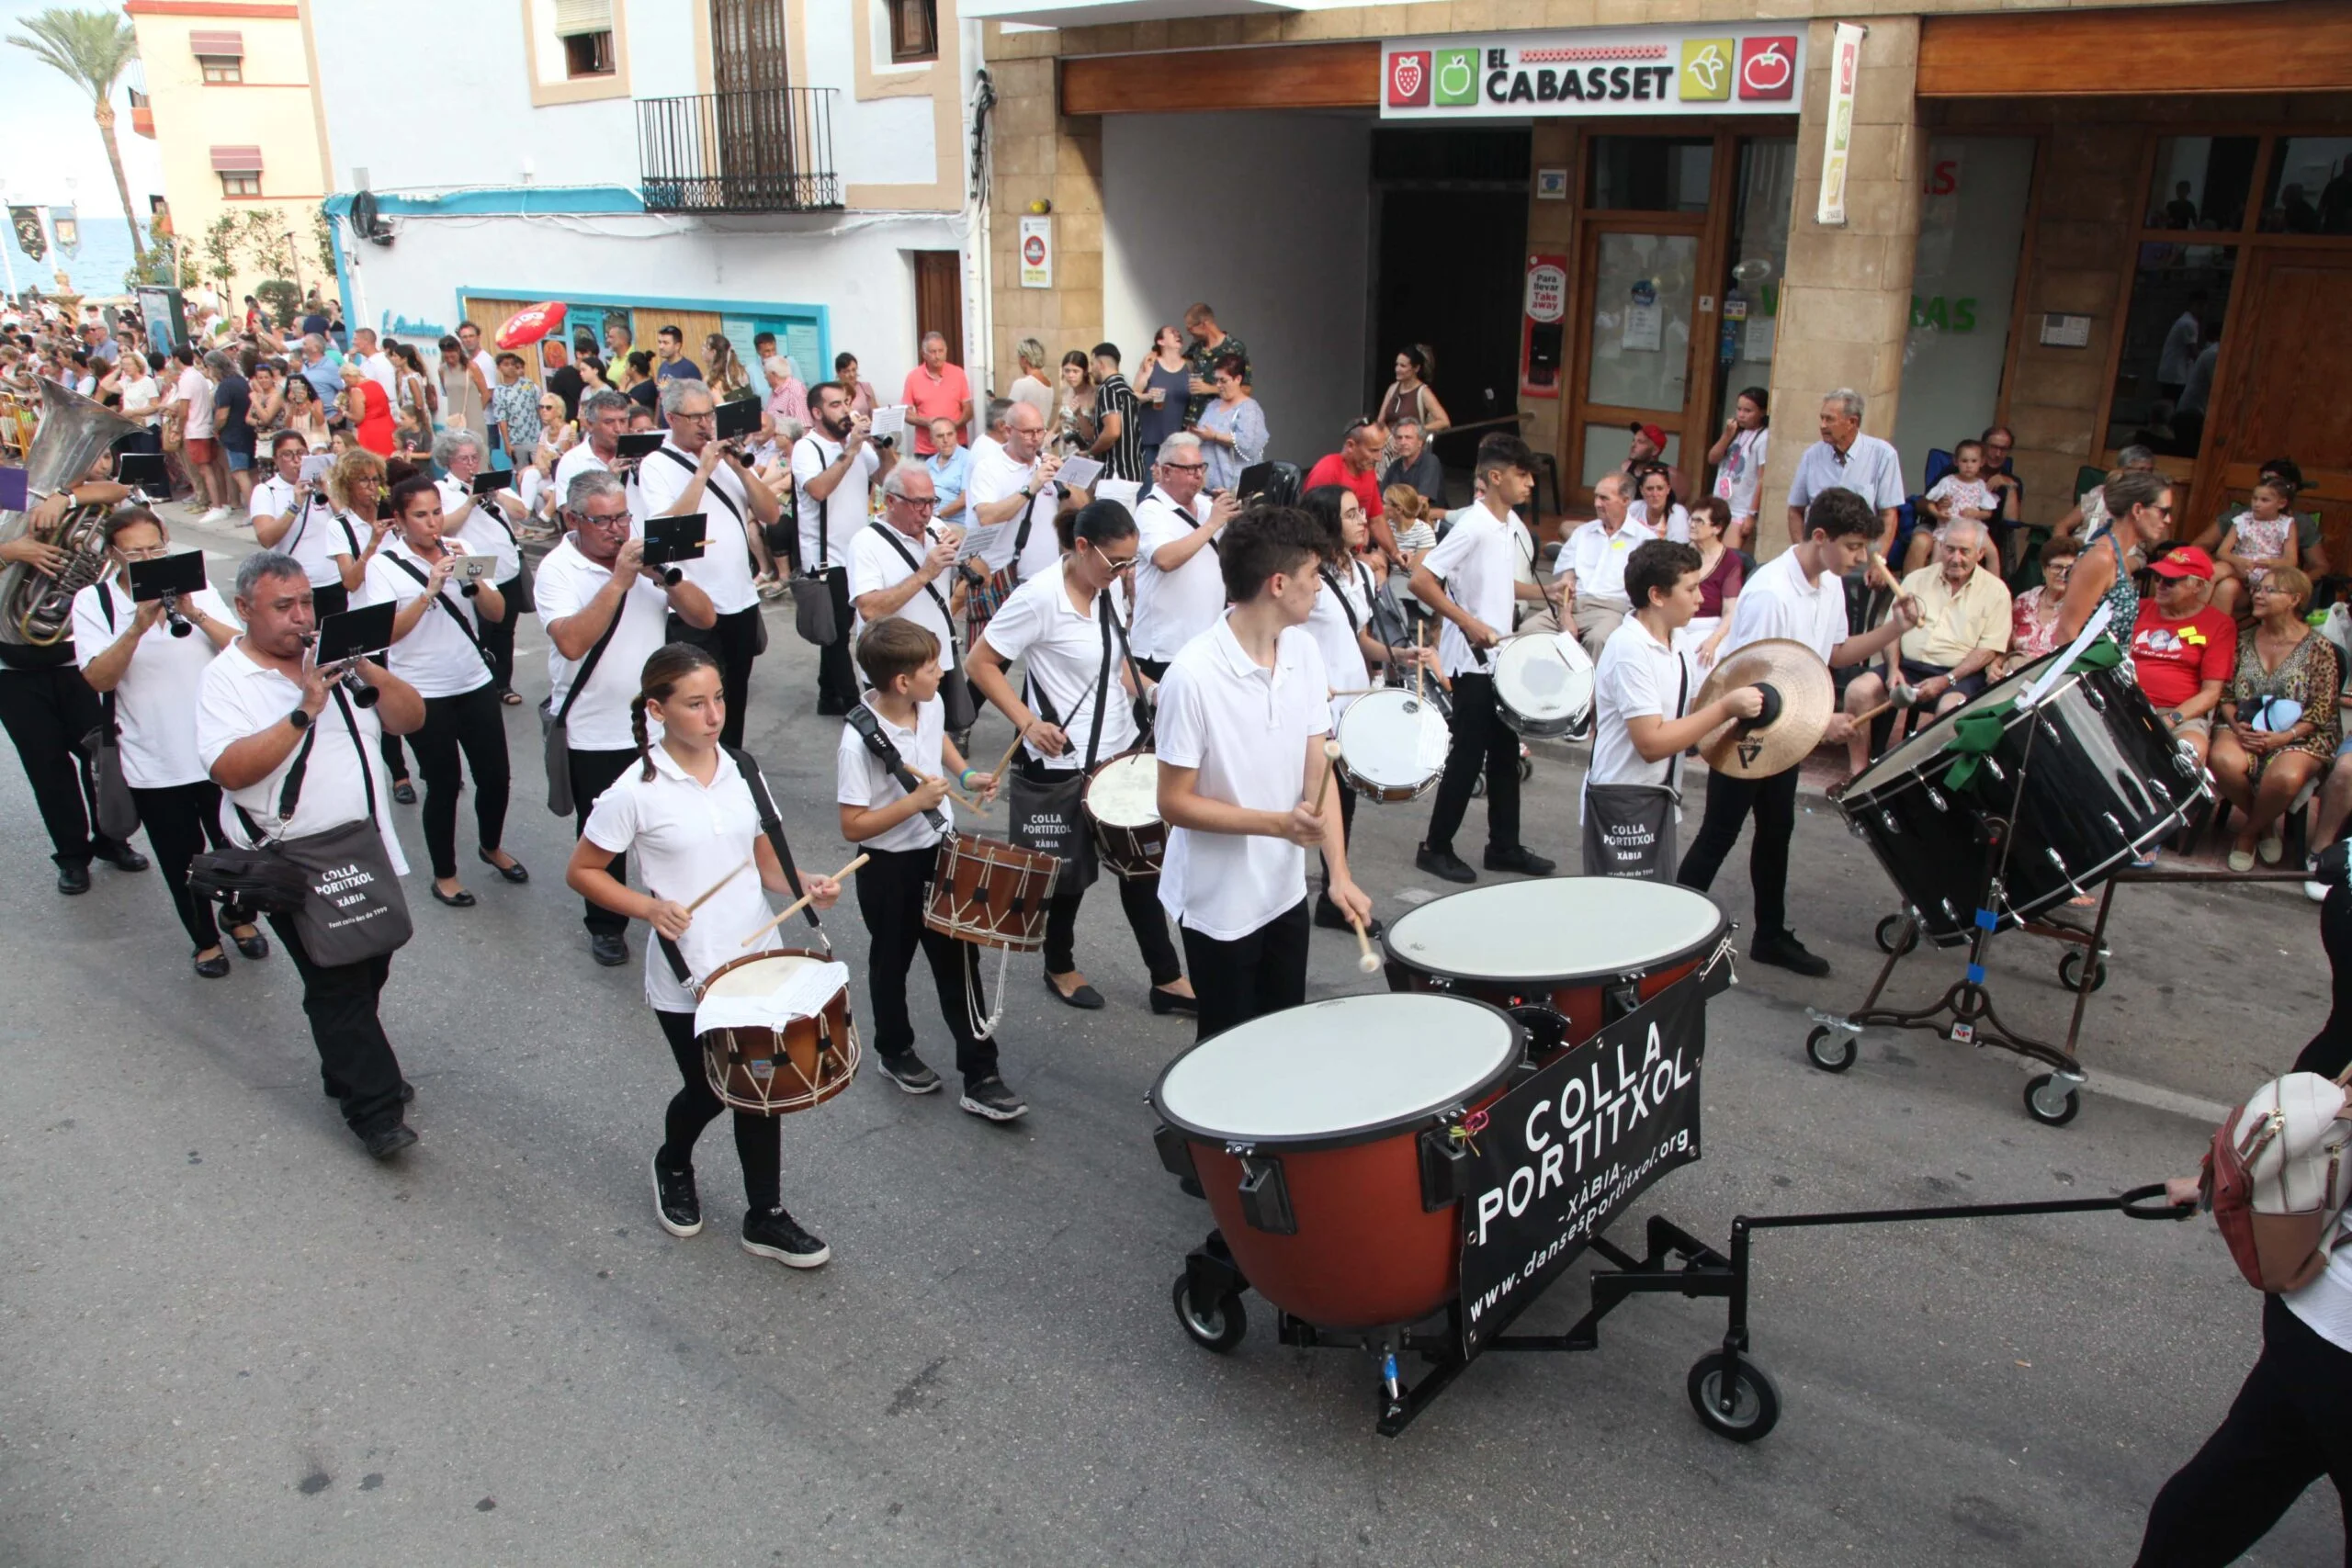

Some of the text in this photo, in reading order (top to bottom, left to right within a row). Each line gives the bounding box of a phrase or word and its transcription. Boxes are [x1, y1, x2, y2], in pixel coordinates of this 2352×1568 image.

[1487, 48, 1510, 69] EL
[1487, 65, 1674, 103] CABASSET
[1536, 274, 1557, 283] Para
[1533, 282, 1559, 292] llevar
[1533, 292, 1558, 301] Take
[1532, 301, 1559, 310] away
[1031, 814, 1062, 824] COLLA
[1023, 824, 1072, 835] PORTITXOL
[1611, 823, 1646, 835] COLLA
[1035, 839, 1059, 848] XÀBIA
[1603, 833, 1656, 846] PORTITXOL
[1617, 851, 1643, 861] XÀBIA
[322, 863, 359, 882] COLLA
[314, 872, 375, 896] PORTITXOL
[336, 893, 367, 908] XÀBIA
[328, 920, 343, 929] Fent
[342, 917, 356, 925] colla
[373, 907, 388, 916] 1999
[1525, 1021, 1661, 1152] COLLA
[1477, 1046, 1691, 1247] PORTITXOL
[1470, 1128, 1689, 1323] www.dansesportitxol.org
